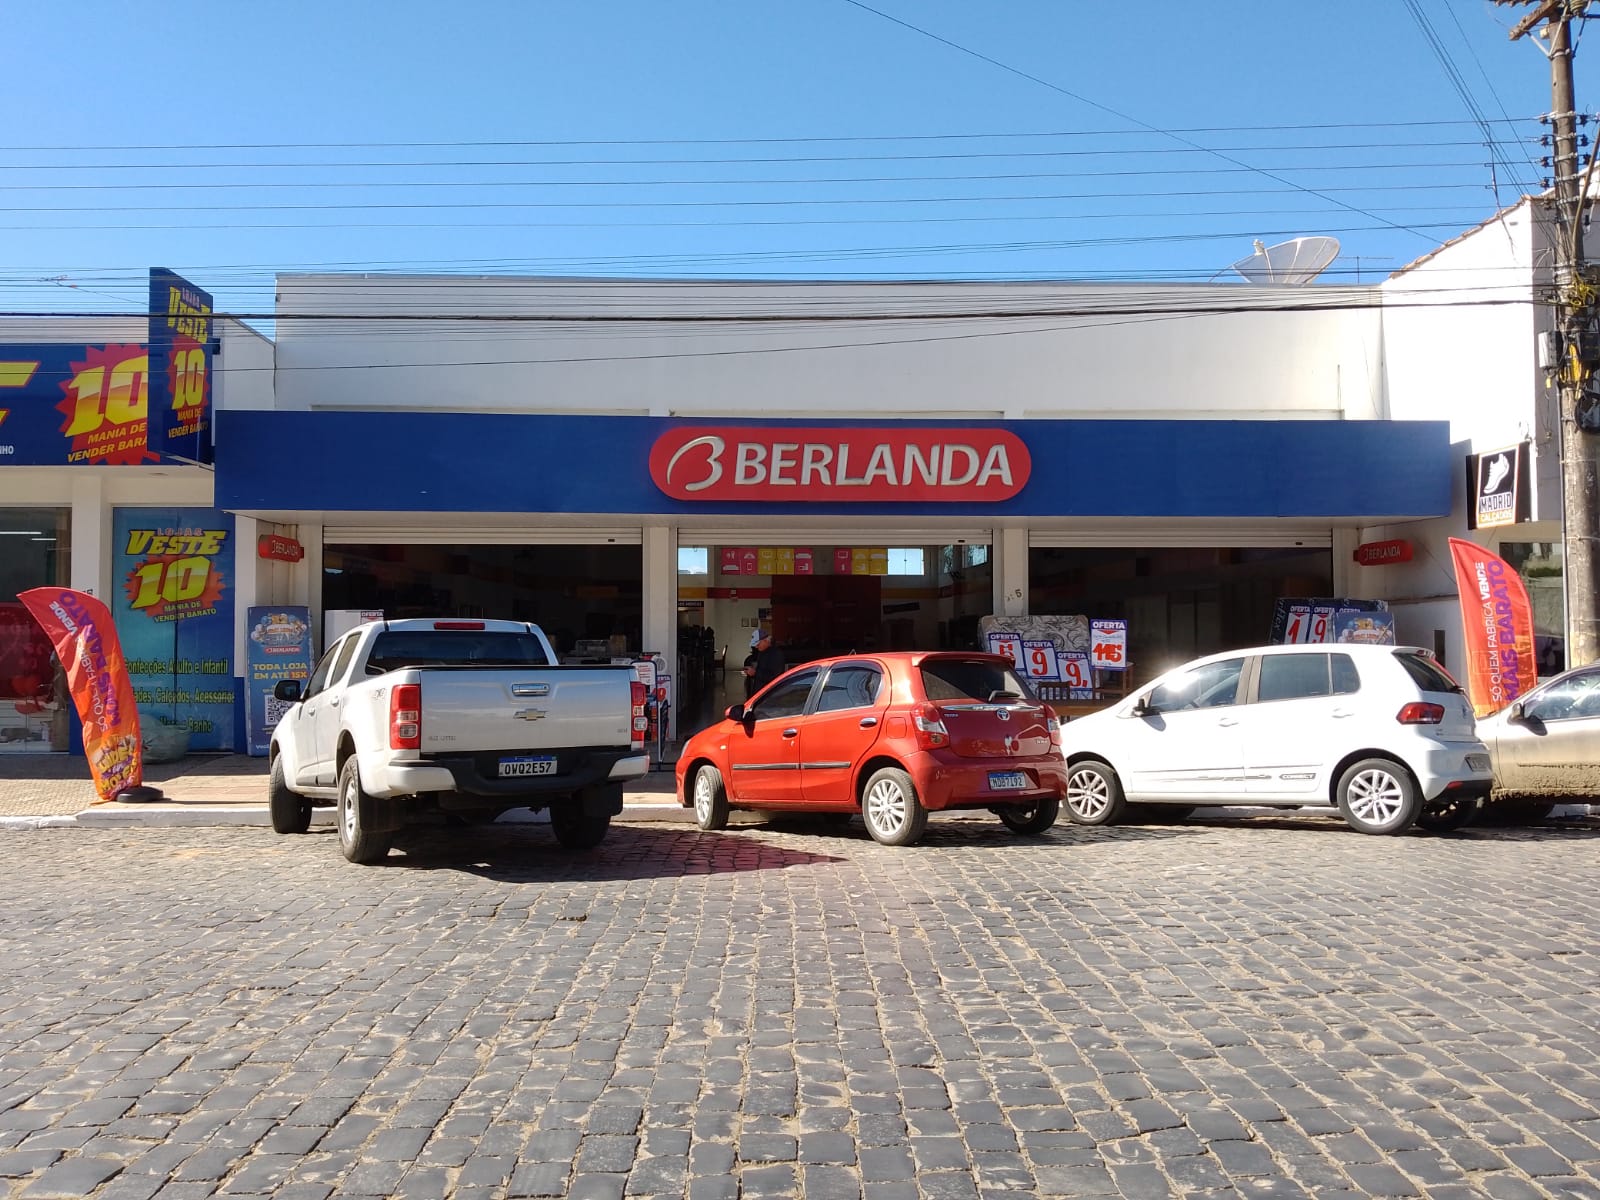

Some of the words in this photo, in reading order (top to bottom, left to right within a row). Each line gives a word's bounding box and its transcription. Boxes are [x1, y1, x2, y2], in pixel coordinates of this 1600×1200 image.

[172, 349, 206, 410] 10
[64, 356, 148, 438] 10
[87, 428, 127, 445] MANIA
[130, 422, 147, 435] DE
[68, 444, 115, 463] VENDER
[734, 443, 1014, 487] BERLANDA
[1480, 493, 1513, 512] MADRID
[126, 530, 227, 555] VESTE
[131, 556, 212, 609] 10
[1475, 561, 1491, 600] VENDE
[1289, 605, 1311, 613] OFERTA
[1313, 606, 1335, 614] OFERTA
[1487, 560, 1516, 645] BARATO
[49, 600, 78, 636] VENDE
[1092, 621, 1126, 629] OFERTA
[1482, 601, 1498, 648] FABRICA
[1023, 640, 1053, 648] OFERTA
[194, 663, 200, 674] e
[202, 658, 228, 674] Infantil
[253, 663, 280, 671] TODA
[282, 662, 307, 670] LOJA
[254, 672, 268, 680] EM
[271, 670, 289, 679] ATÉ
[1032, 651, 1048, 676] 9
[1488, 651, 1503, 685] QUEM
[1500, 648, 1520, 701] MAIS
[1489, 686, 1502, 703] SÓ
[504, 762, 552, 775] OWQ2E57
